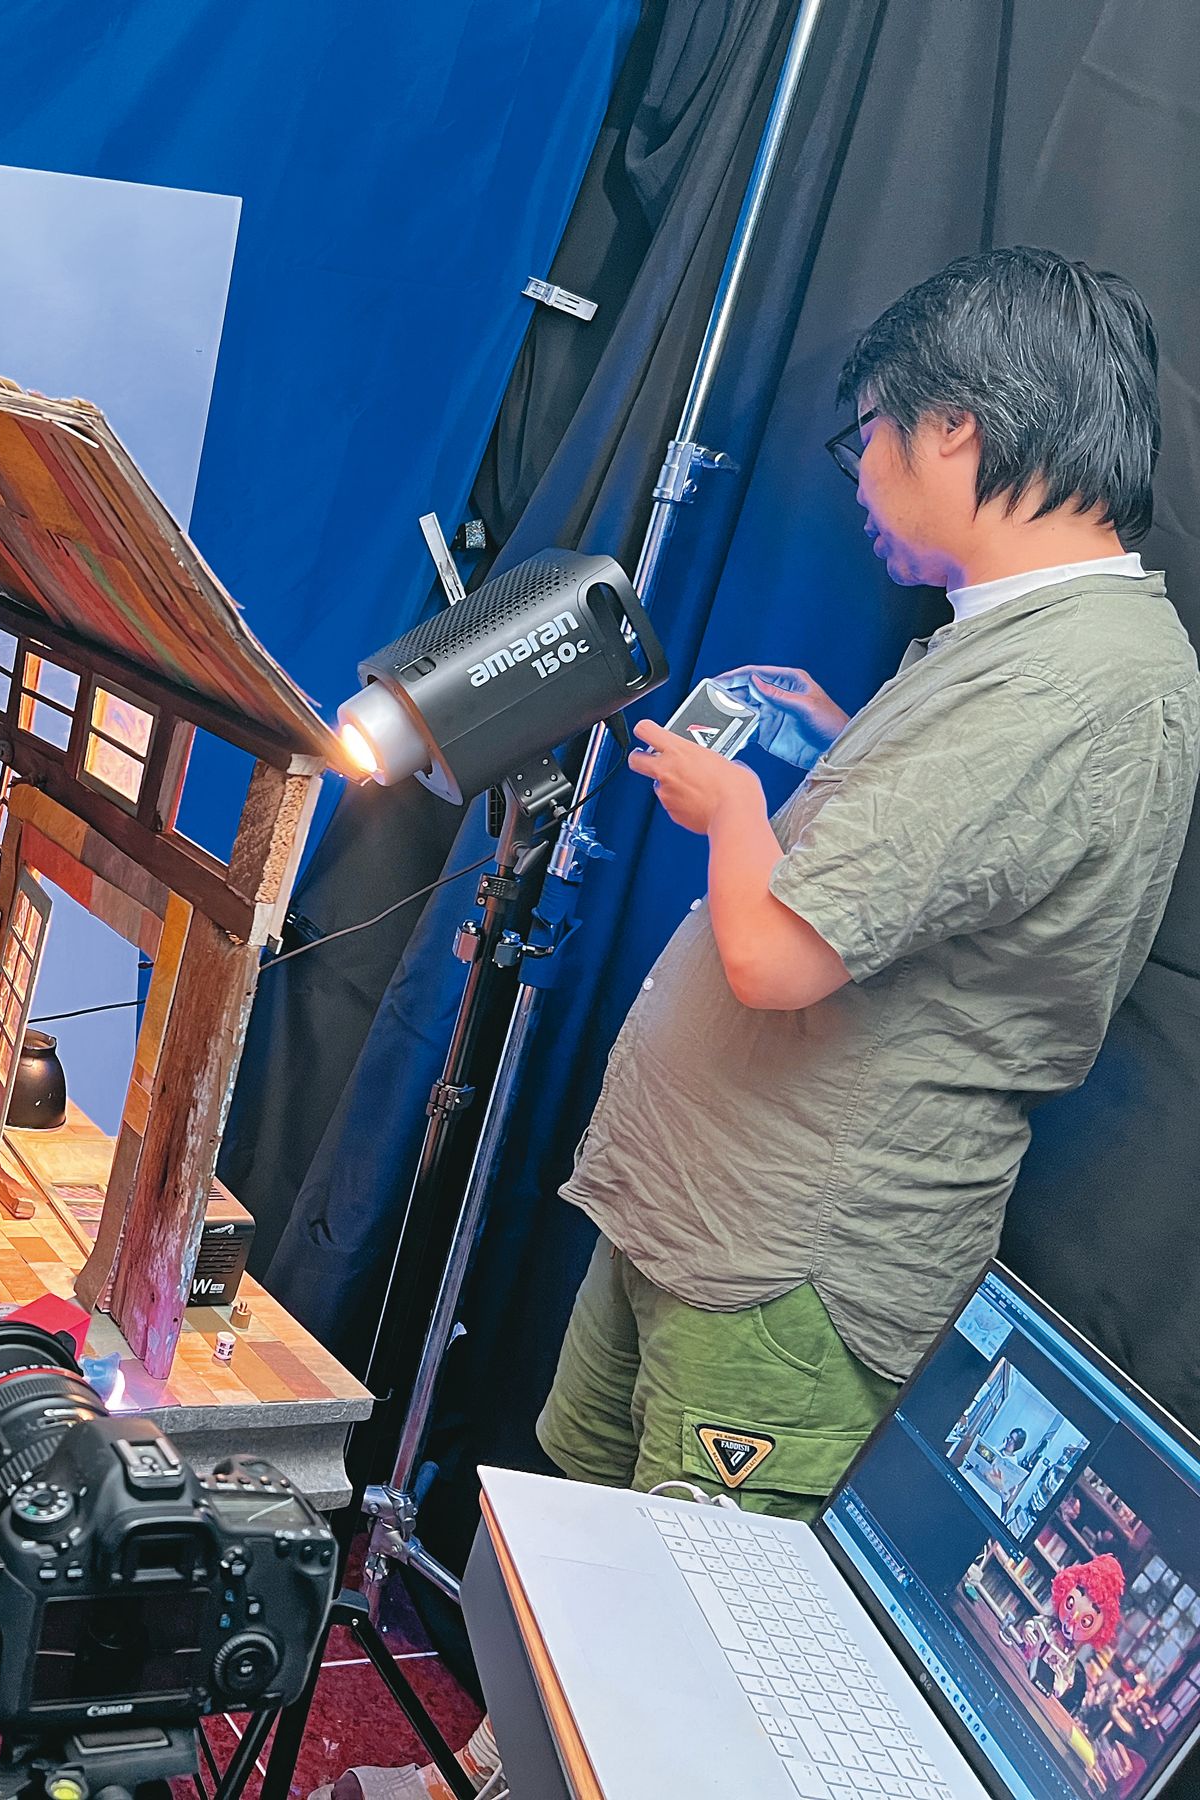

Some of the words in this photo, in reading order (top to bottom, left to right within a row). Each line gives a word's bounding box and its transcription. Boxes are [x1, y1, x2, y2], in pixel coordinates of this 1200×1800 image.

[466, 611, 580, 688] amaran
[531, 639, 590, 679] 150c
[87, 1704, 133, 1717] Canon
